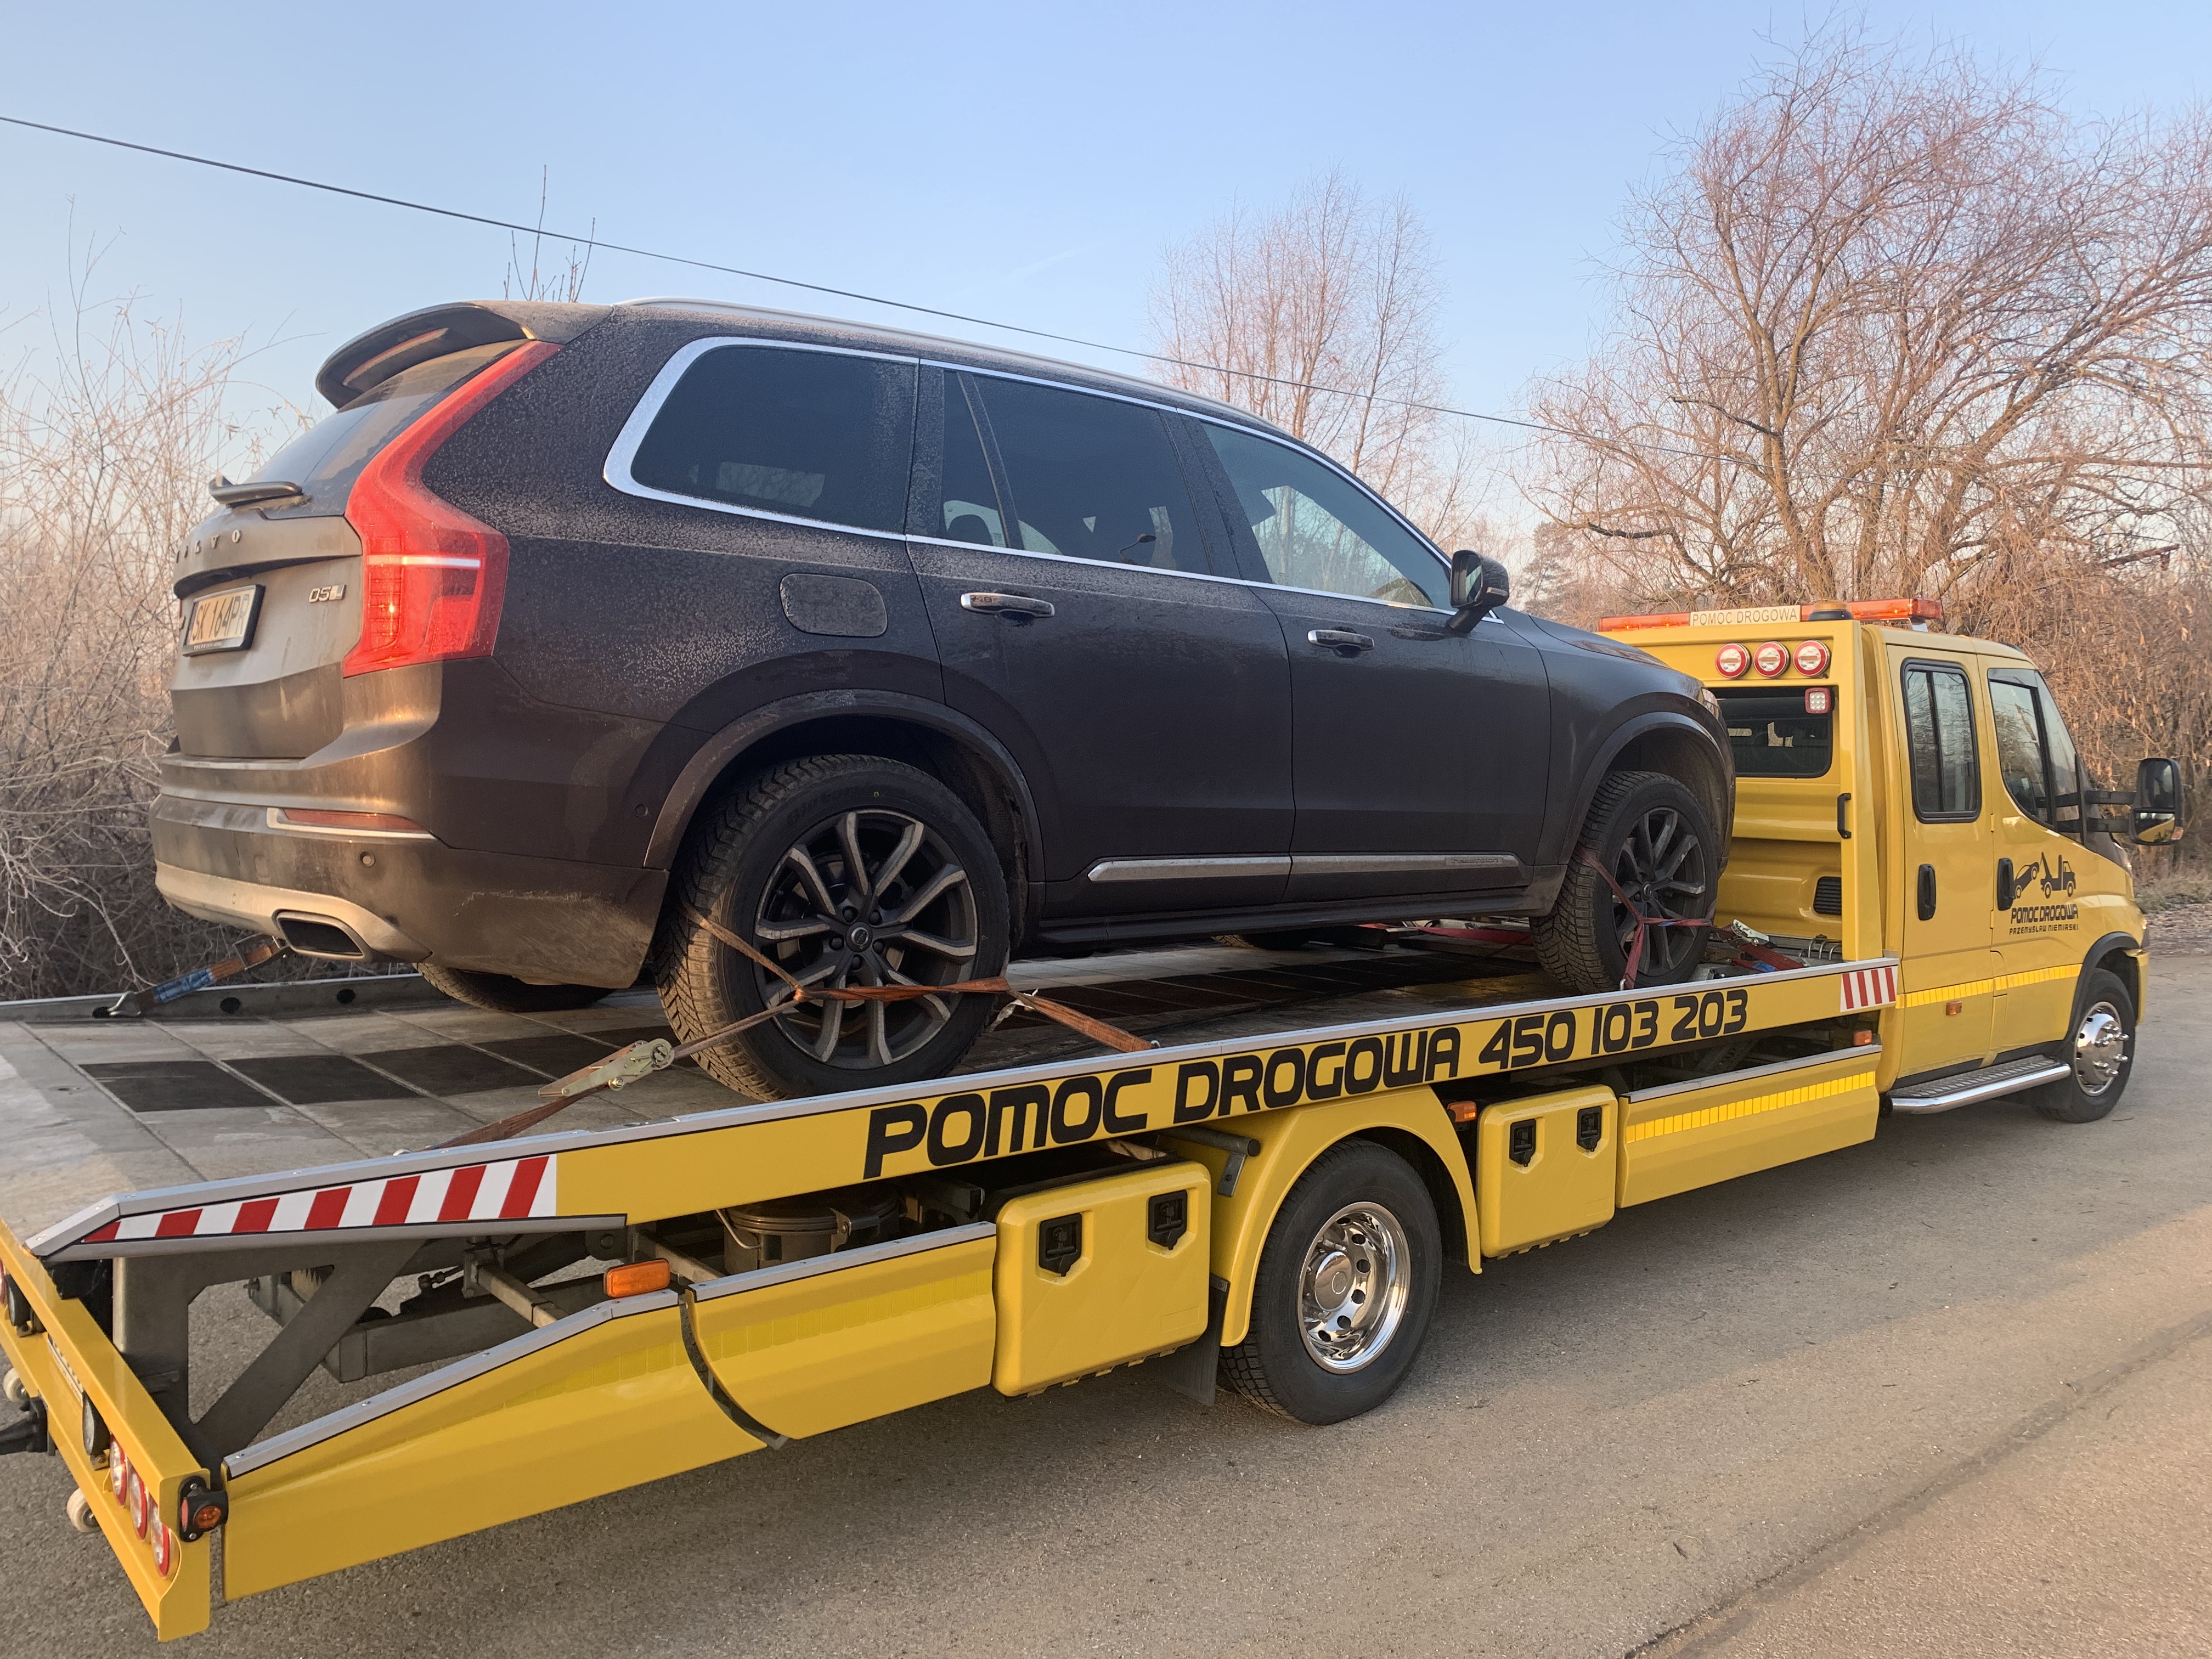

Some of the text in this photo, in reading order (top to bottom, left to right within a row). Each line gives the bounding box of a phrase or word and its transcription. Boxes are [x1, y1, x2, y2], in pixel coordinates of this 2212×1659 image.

[309, 585, 331, 602] D5
[193, 594, 250, 641] SK 164PR
[1692, 607, 1797, 626] POMOC DROGOWA
[2011, 904, 2079, 924] POMOC DROGOWA
[863, 989, 1748, 1180] POMOC DROGOWA 450 103 203
